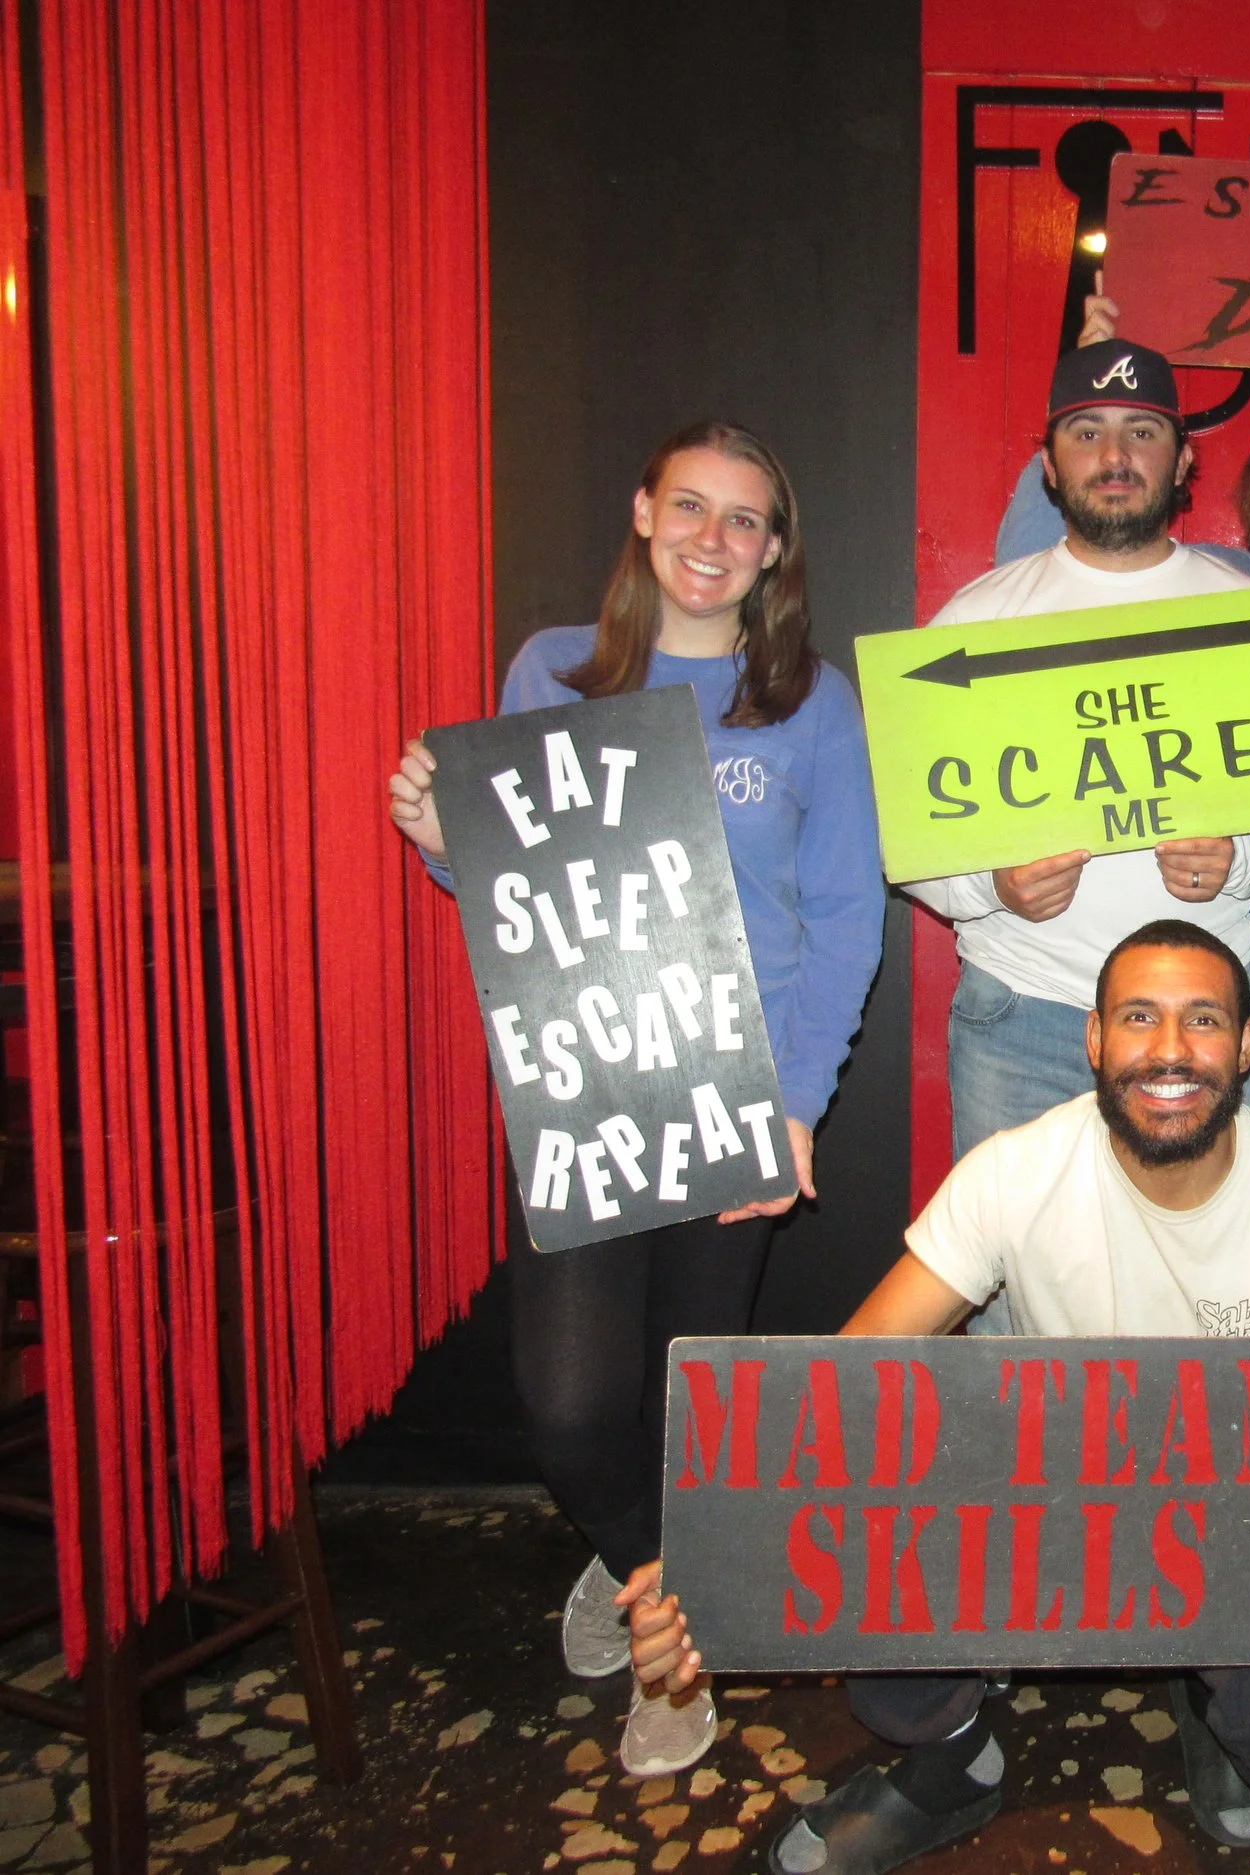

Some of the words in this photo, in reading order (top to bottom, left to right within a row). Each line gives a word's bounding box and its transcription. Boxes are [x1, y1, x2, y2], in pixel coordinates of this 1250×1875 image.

[1092, 355, 1138, 390] A
[1074, 682, 1171, 730] SHE
[490, 731, 637, 849] EAT
[1102, 796, 1177, 843] ME
[494, 839, 693, 969] SLEEP
[491, 962, 744, 1100] ESCAPE
[529, 1082, 780, 1222] REPEAT
[675, 1358, 942, 1489] MAD
[783, 1499, 1207, 1635] SKILLS
